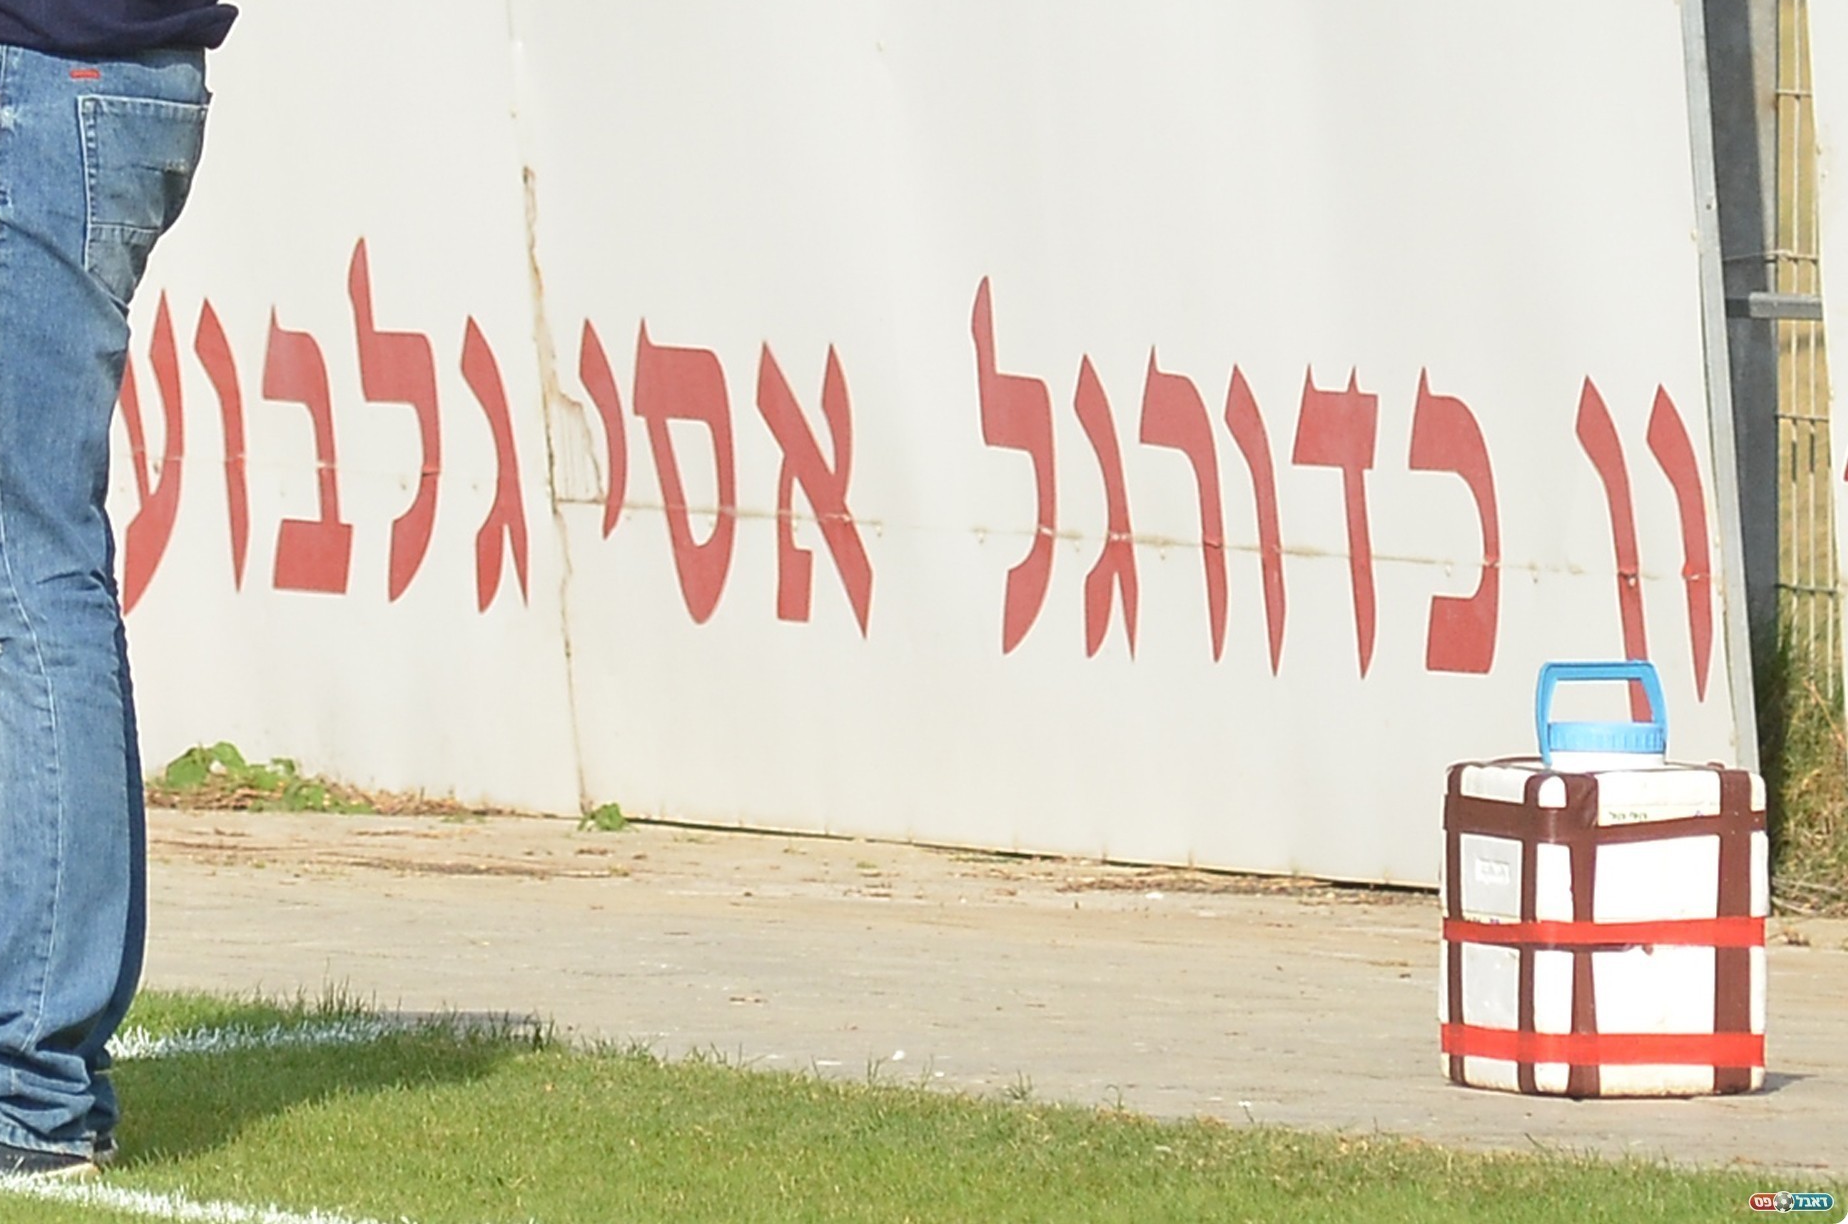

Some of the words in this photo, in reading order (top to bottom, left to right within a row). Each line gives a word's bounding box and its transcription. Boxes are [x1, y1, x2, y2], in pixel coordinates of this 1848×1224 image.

[118, 236, 530, 616] גלבוע
[579, 317, 874, 639] אסי
[970, 274, 1502, 678] כדורגל
